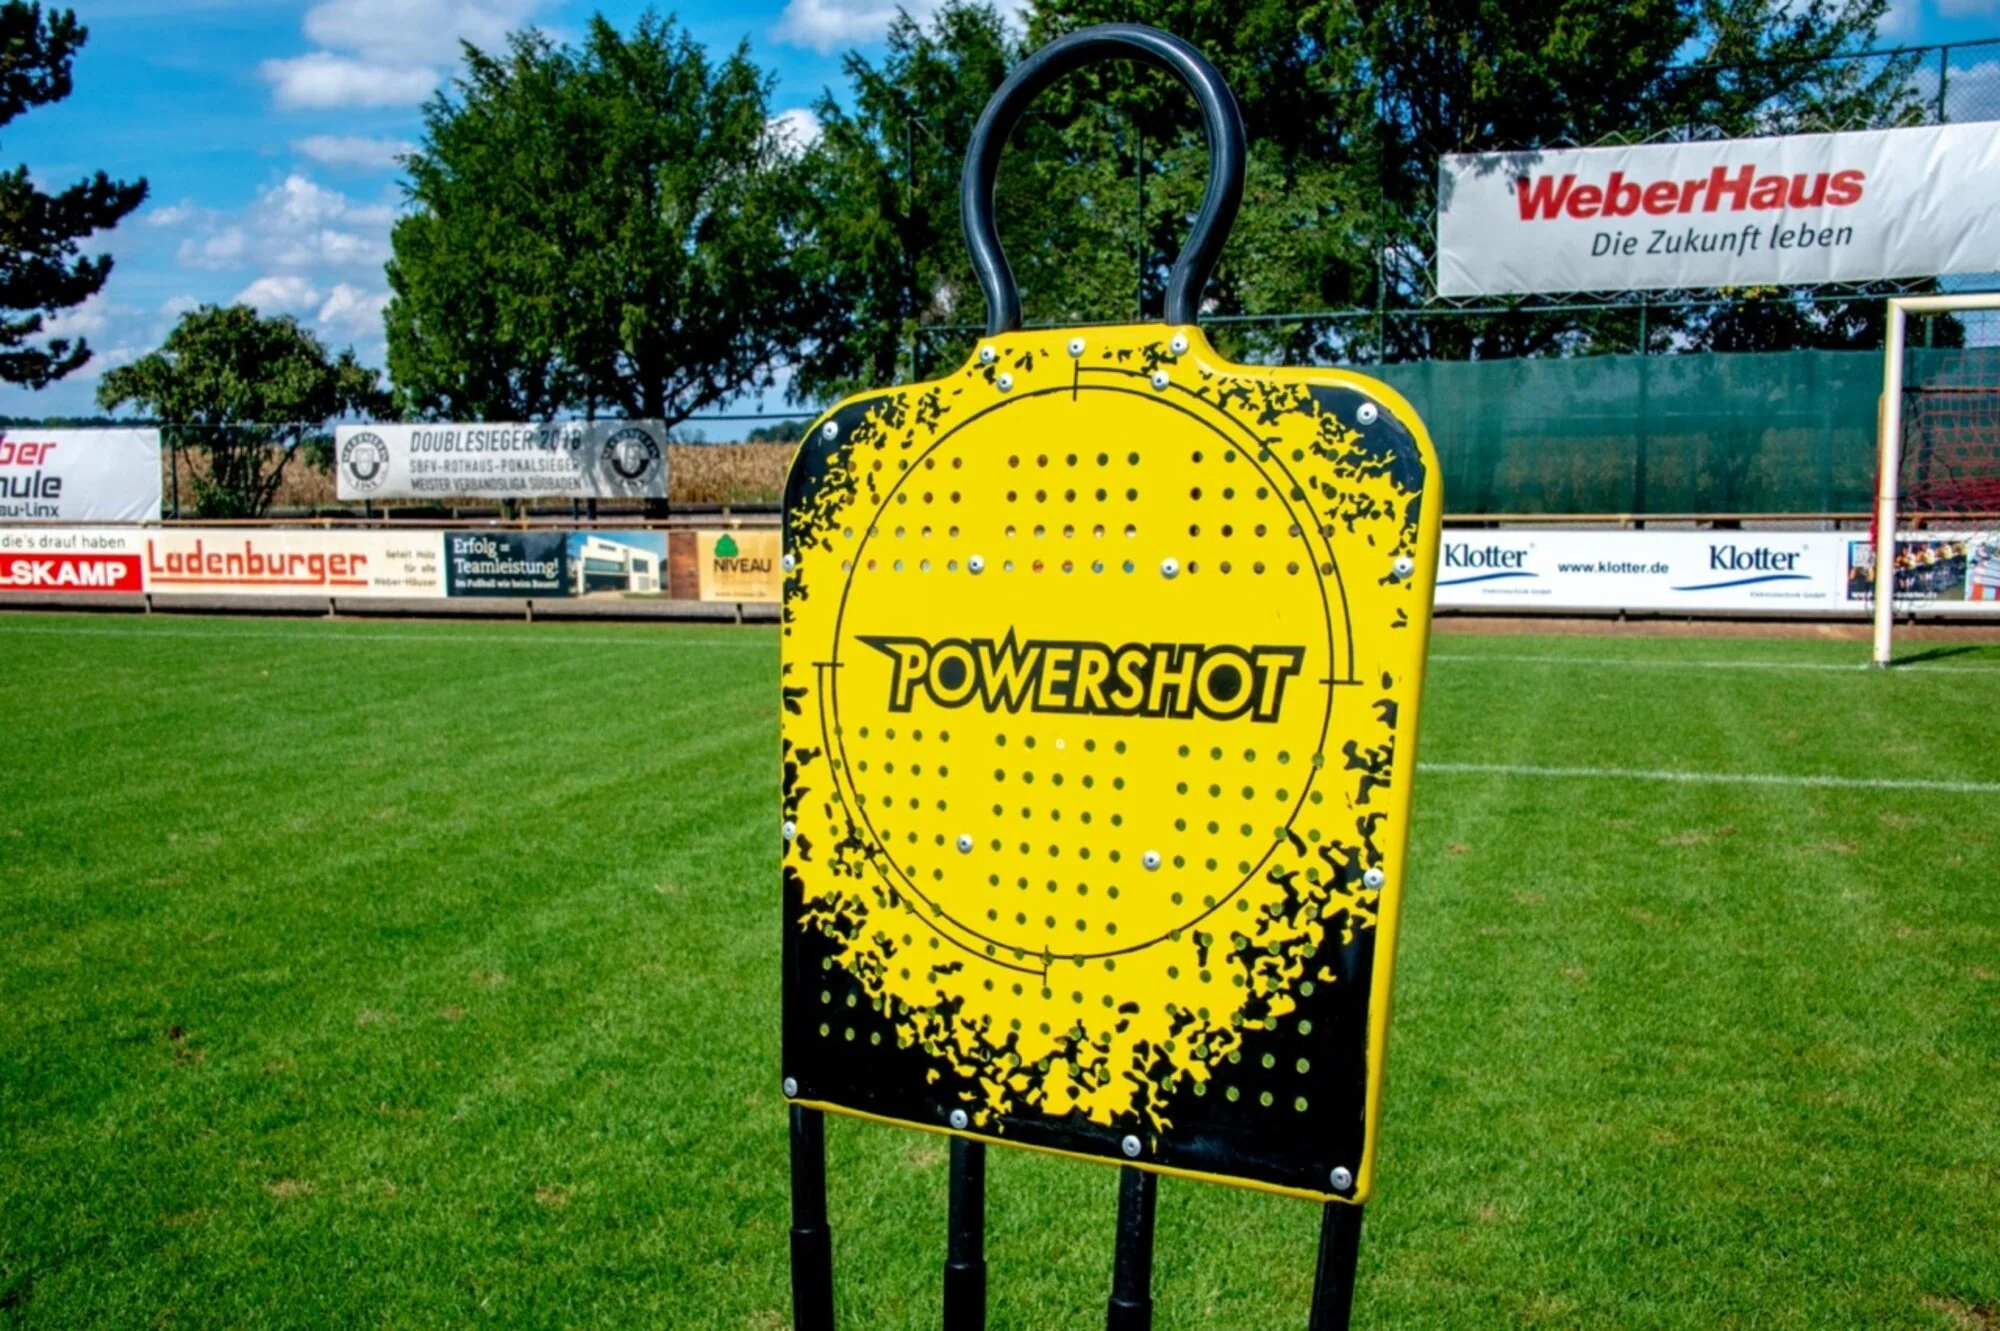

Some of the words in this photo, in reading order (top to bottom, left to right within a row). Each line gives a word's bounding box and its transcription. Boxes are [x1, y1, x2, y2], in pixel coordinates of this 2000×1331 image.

[1515, 163, 1866, 221] WeberHaus
[1590, 230, 1637, 257] Die
[1647, 225, 1763, 257] Zukunft
[1768, 221, 1854, 249] leben
[410, 429, 534, 452] DOUBLESIEGER
[538, 429, 583, 451] 2018
[409, 477, 454, 492] MEISTER
[453, 475, 527, 492] VERBANDSLIGA
[39, 532, 77, 548] drauf
[81, 532, 125, 548] haben
[453, 537, 497, 559] Erfolg
[148, 538, 368, 584] Ladenburger
[713, 557, 773, 574] NIVEAU
[1443, 542, 1528, 569] Klotter
[1557, 559, 1669, 575] www.klotter.de
[1709, 544, 1800, 571] Klotter
[453, 557, 560, 580] Teamleistung!
[854, 625, 1307, 723] POWERSHOT
